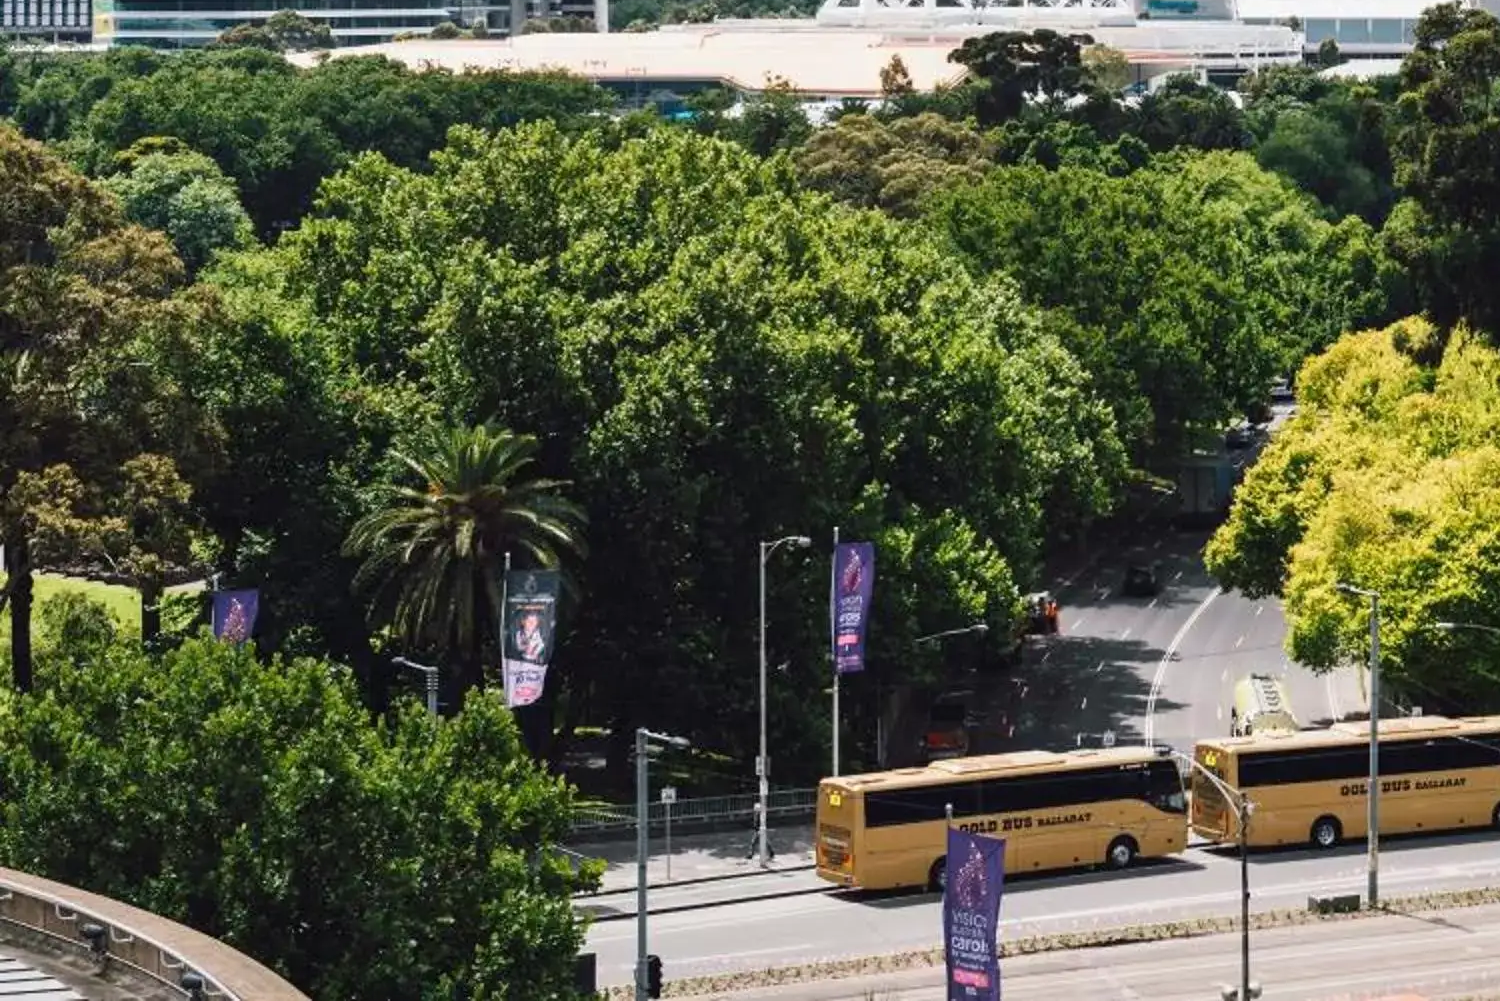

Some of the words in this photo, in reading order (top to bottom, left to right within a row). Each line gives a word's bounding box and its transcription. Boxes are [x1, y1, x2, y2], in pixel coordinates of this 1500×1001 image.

[1340, 783, 1368, 796] GOL
[1382, 779, 1411, 793] BUS
[1002, 816, 1033, 831] BUS
